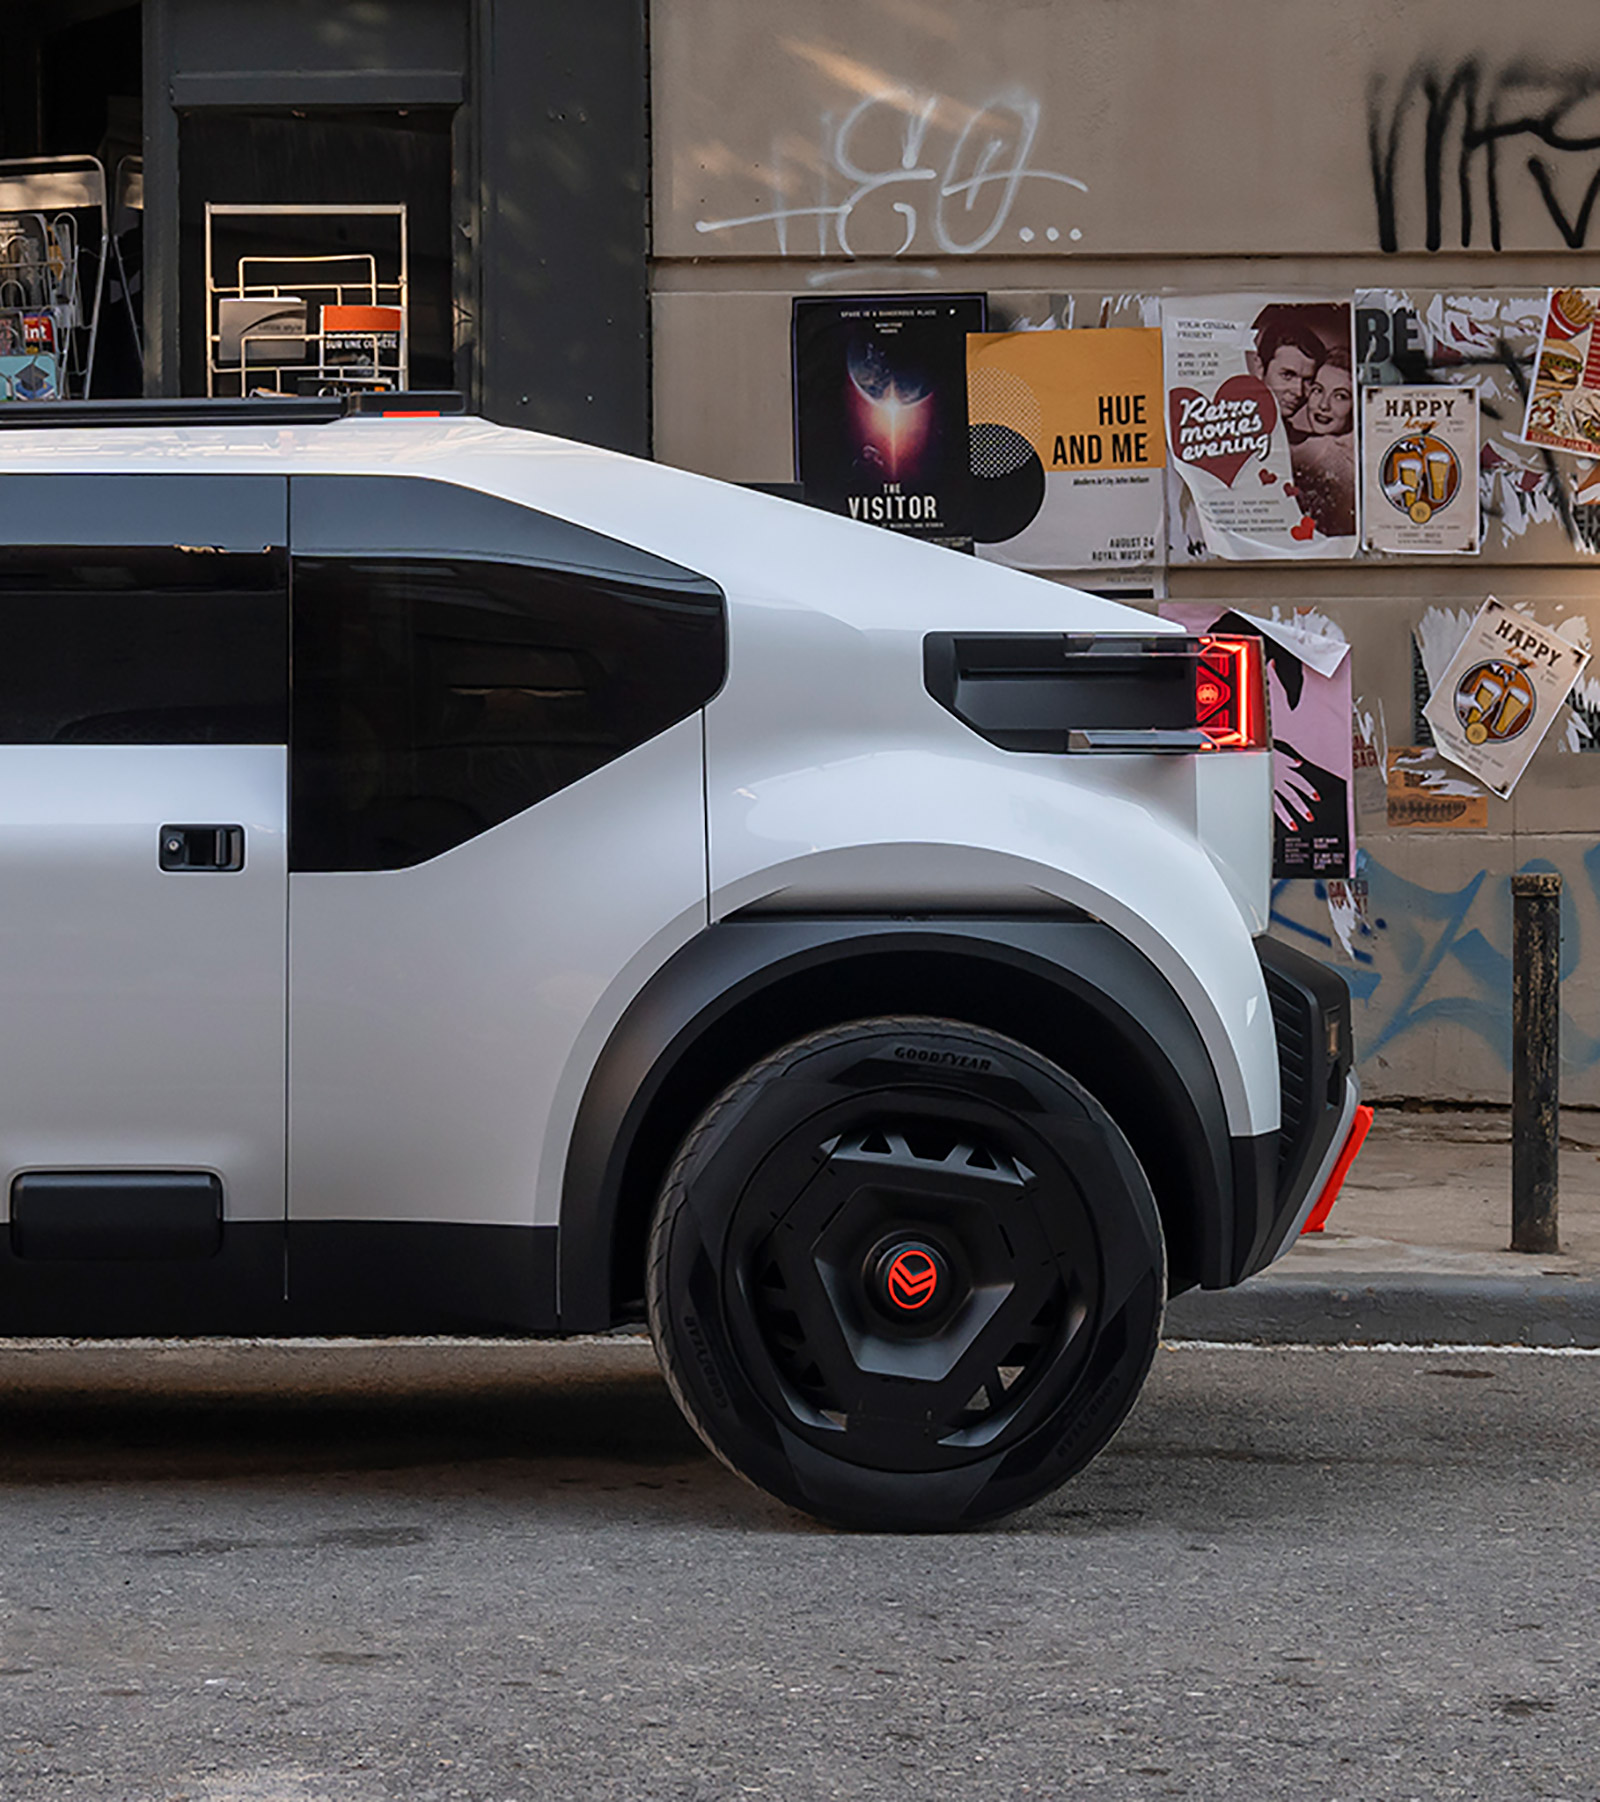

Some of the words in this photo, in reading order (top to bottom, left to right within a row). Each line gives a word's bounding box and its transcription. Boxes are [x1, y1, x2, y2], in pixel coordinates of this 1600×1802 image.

[1098, 395, 1147, 426] HUE
[1179, 397, 1257, 427] Retro
[1385, 399, 1455, 417] HAPPY
[1180, 413, 1263, 445] movies
[1052, 434, 1103, 465] AND
[1112, 433, 1148, 463] ME
[1182, 434, 1270, 462] evening
[883, 482, 901, 494] THE
[848, 495, 937, 520] VISITOR
[1495, 619, 1562, 667] HAPPY
[894, 1046, 993, 1072] GOODYEAR
